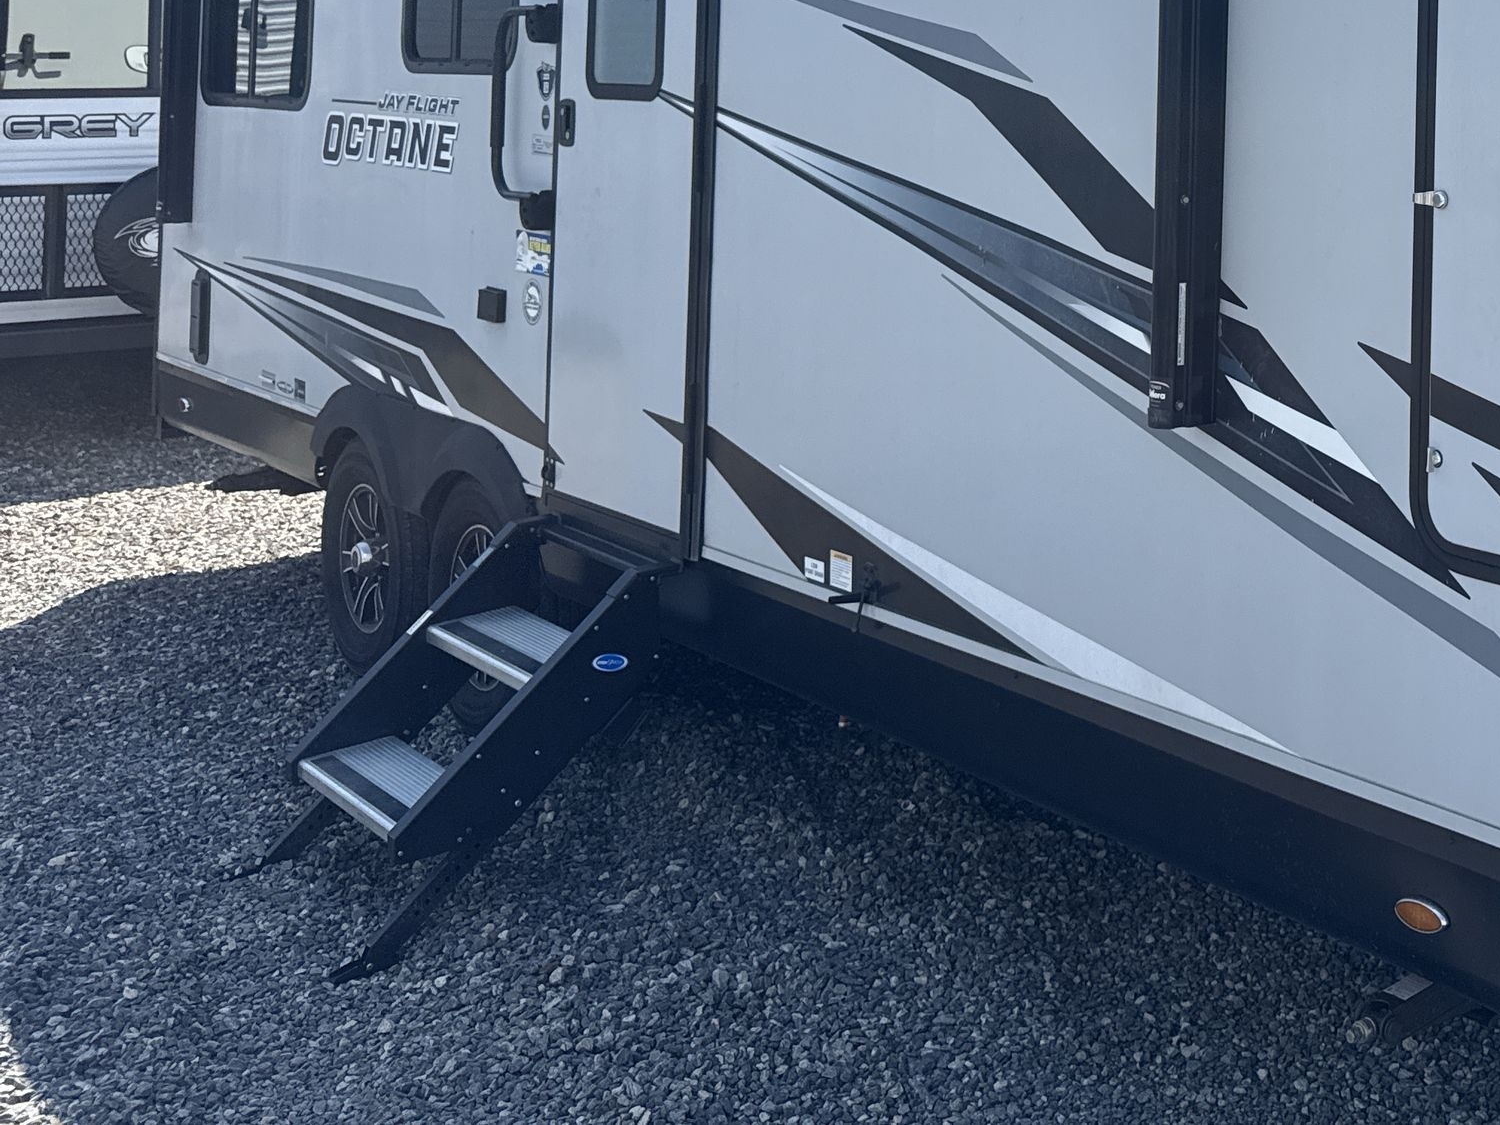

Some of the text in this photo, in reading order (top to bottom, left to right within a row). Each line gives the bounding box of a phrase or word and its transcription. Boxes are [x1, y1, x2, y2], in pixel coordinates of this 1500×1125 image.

[378, 92, 460, 115] JAY FLIGHT
[3, 112, 156, 140] GREY
[322, 111, 460, 174] OCTANE
